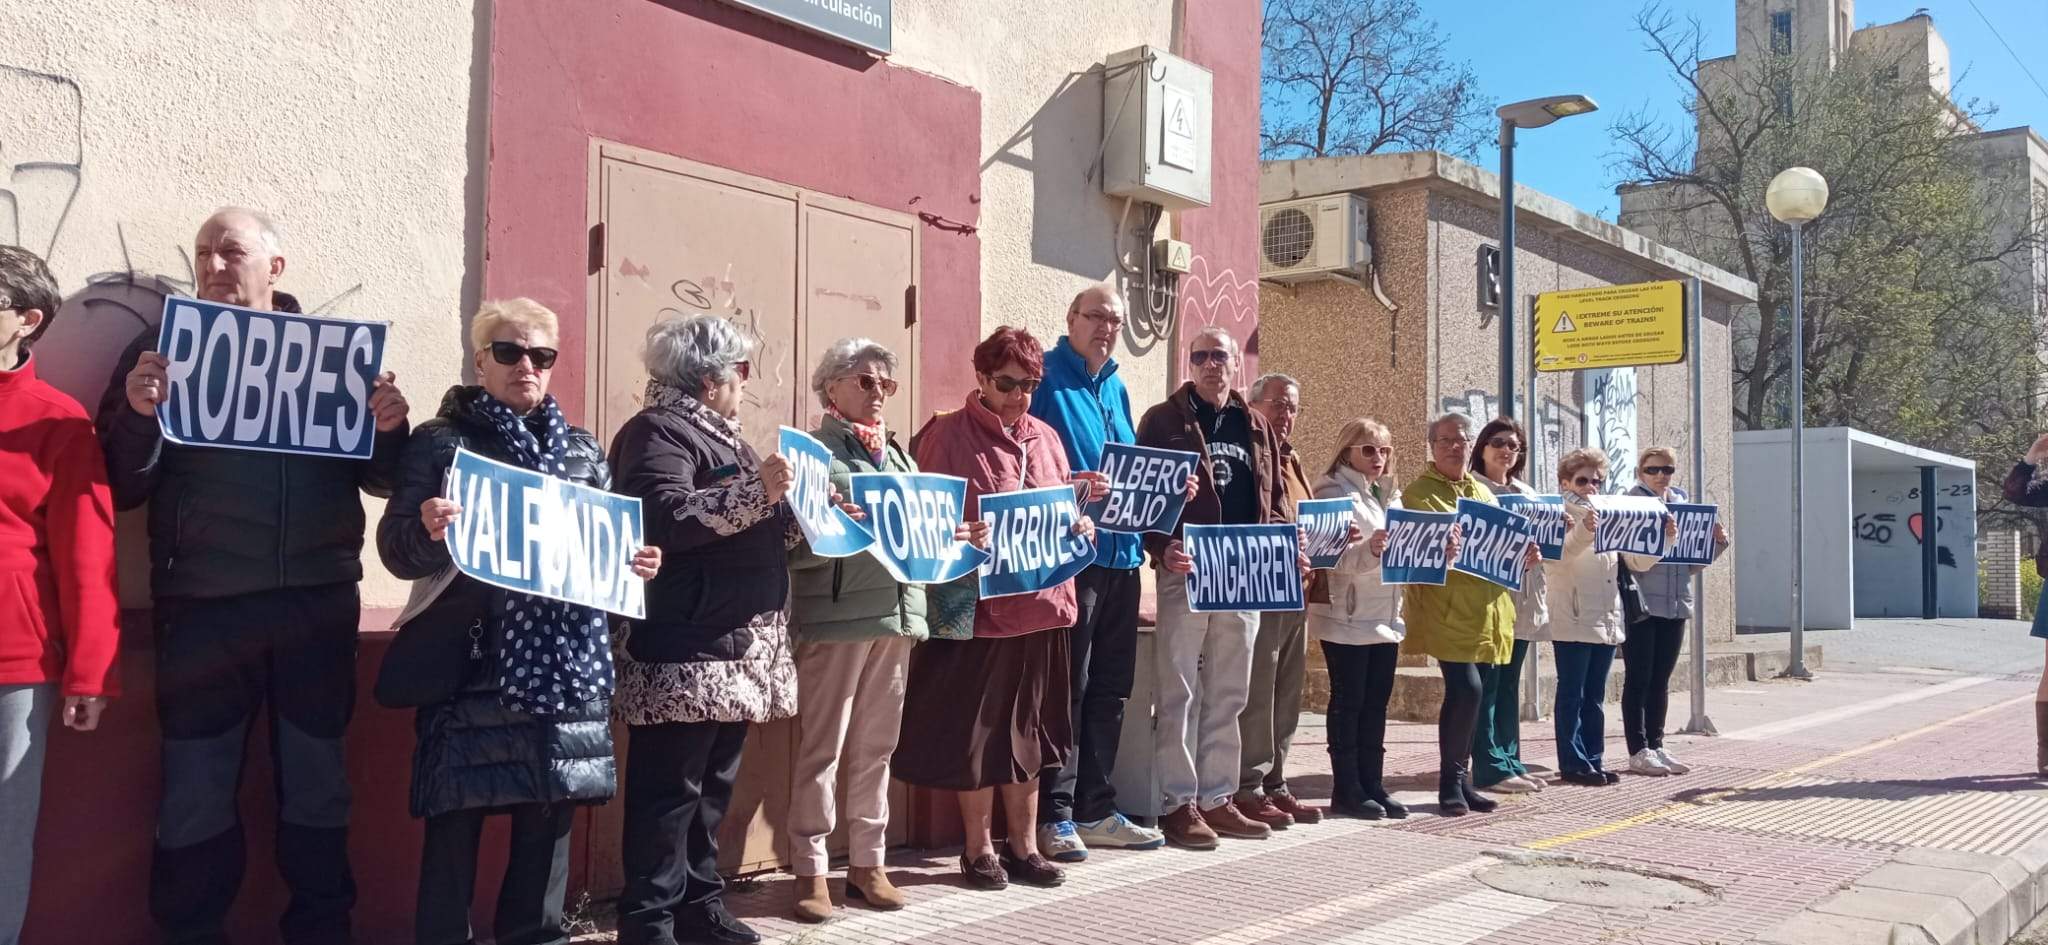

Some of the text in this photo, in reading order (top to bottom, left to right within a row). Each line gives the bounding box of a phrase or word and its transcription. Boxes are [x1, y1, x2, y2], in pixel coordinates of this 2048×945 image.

[803, 0, 882, 28] culación
[1576, 309, 1611, 320] ¡EXTREME
[1624, 306, 1664, 315] ATENCIÓN!
[1584, 319, 1613, 328] BEWARE
[1626, 316, 1656, 325] TRAINS!
[163, 305, 373, 452] ROBRES
[1100, 452, 1192, 495] ALBERO
[865, 488, 962, 561] TORRES
[1100, 491, 1167, 528] BAJO
[1187, 535, 1297, 604] SANGARREN
